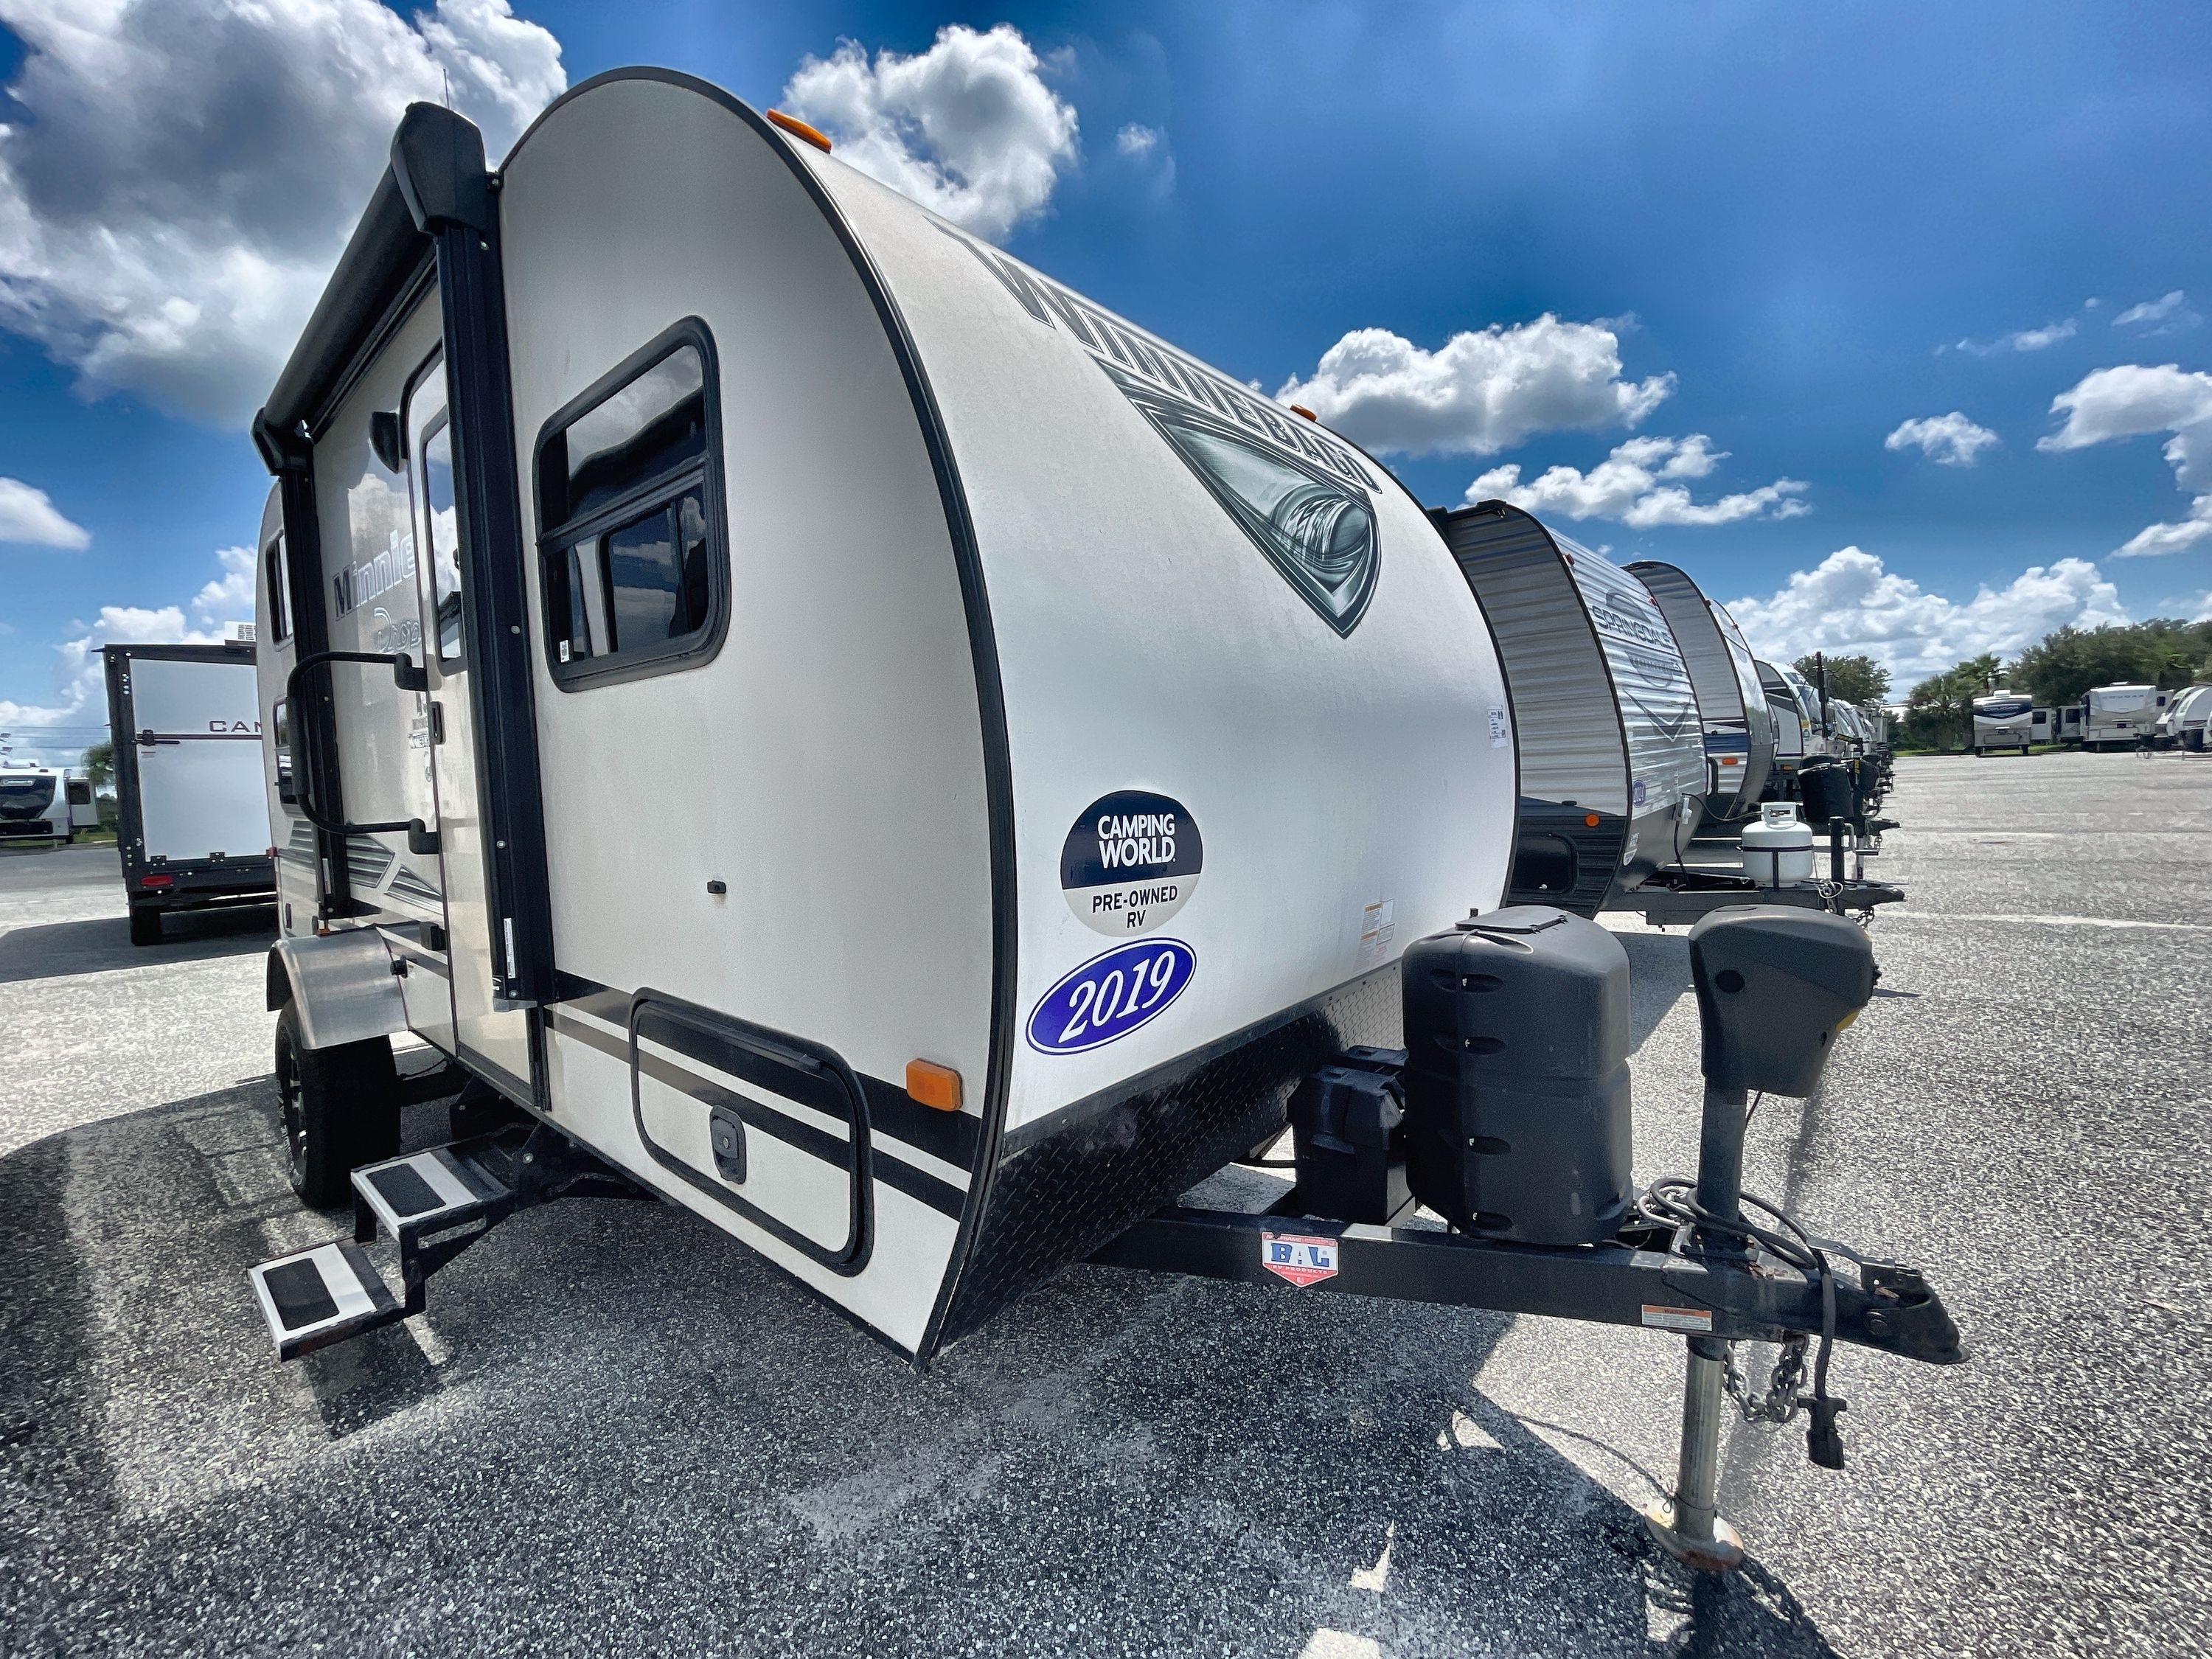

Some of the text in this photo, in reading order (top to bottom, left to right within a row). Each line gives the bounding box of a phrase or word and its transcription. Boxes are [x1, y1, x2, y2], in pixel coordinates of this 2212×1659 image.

[923, 216, 1382, 494] WINNEBAGO
[333, 529, 417, 622] Minnie
[1592, 605, 1674, 650] SPRINGDALE
[1097, 813, 1175, 840] CAMPING
[1099, 836, 1175, 869] WORLD
[1093, 886, 1178, 914] PRE-OWNED
[1127, 910, 1147, 929] RV
[1057, 950, 1175, 1044] 2019
[1270, 1242, 1329, 1267] BAL
[1285, 1266, 1328, 1275] PRODUCTS
